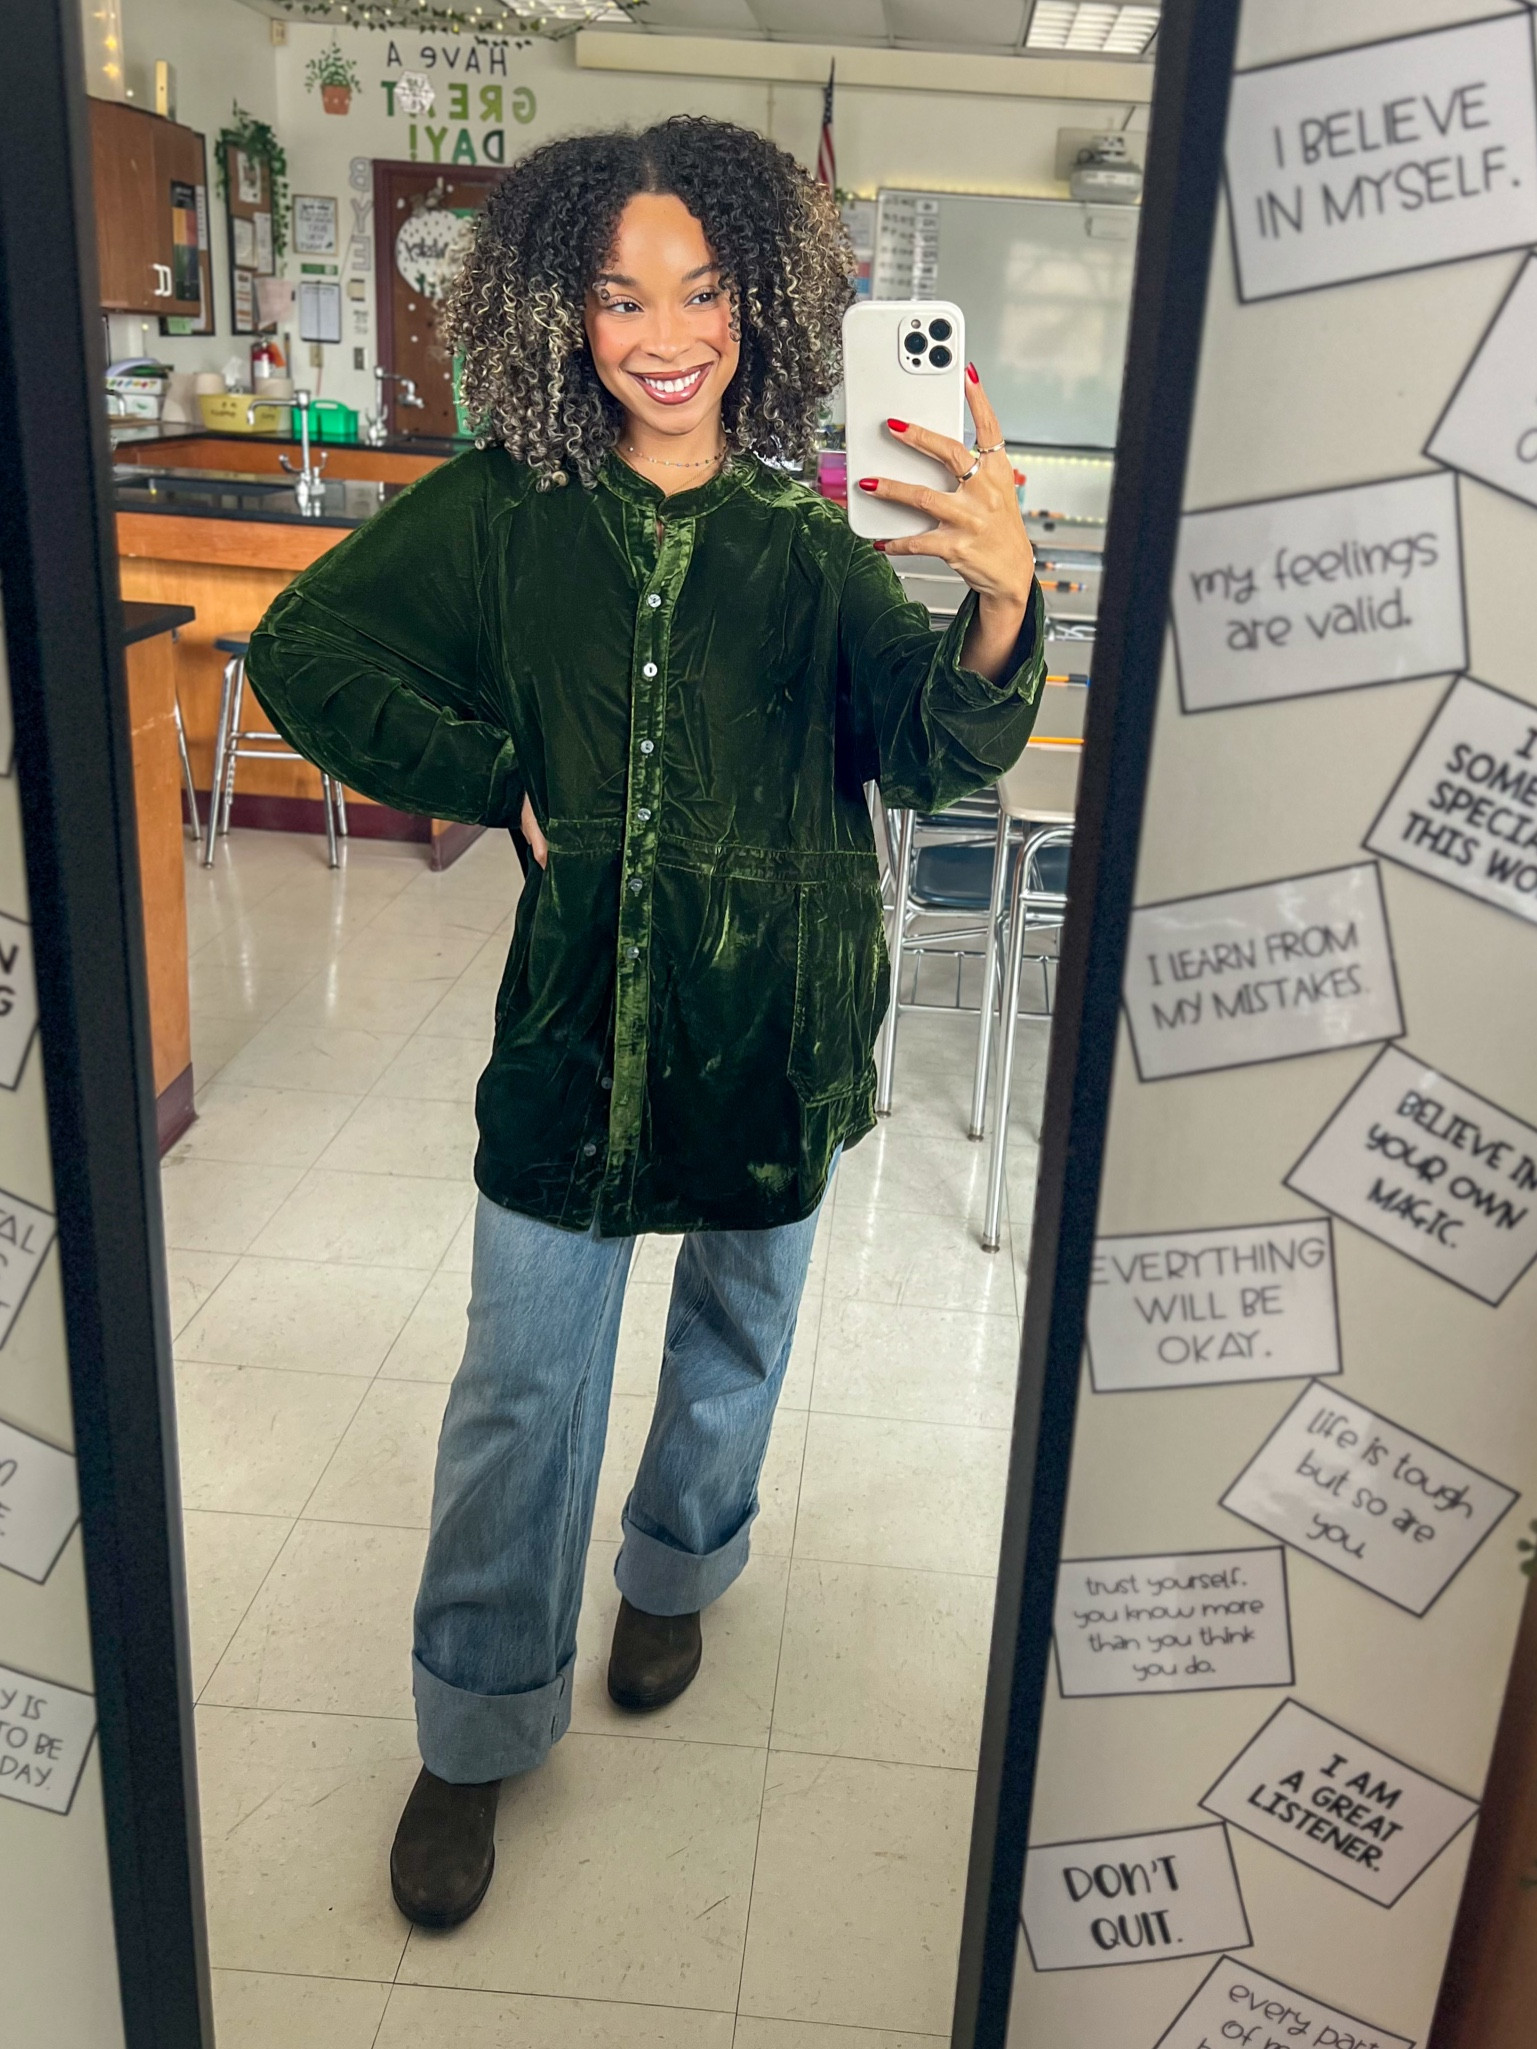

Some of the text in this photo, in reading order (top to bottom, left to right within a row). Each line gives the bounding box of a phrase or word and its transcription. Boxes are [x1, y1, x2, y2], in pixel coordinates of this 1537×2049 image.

[1273, 82, 1490, 170] I BELIEVE
[1256, 145, 1520, 240] IN MYSELF.
[1190, 532, 1438, 605] my feelings
[1225, 587, 1412, 651] are valid.
[1402, 810, 1480, 866] THIS
[1147, 921, 1359, 986] I LEARN FROM
[1151, 964, 1371, 1030] MY MISTAKES.
[1396, 1089, 1537, 1192] BELIEVE IN
[1367, 1176, 1465, 1249] MAGIC.
[1449, 1175, 1529, 1230] OWN
[1091, 1237, 1327, 1286] EVERYTHING
[1133, 1284, 1285, 1325] WILL BE
[1157, 1328, 1273, 1365] OKAY.
[1306, 1407, 1473, 1520] life is tough
[1295, 1448, 1436, 1543] but so are
[1305, 1512, 1366, 1560] you
[1085, 1567, 1248, 1596] trust yourself.
[1074, 1599, 1264, 1629] you know more
[1088, 1625, 1256, 1653] than you think
[1133, 1655, 1216, 1682] you do.
[20, 1694, 48, 1720] IS
[34, 1732, 64, 1761] BE
[1279, 1769, 1404, 1843] A GREAT
[1319, 1753, 1404, 1811] I AM
[1247, 1783, 1384, 1873] LISTENER.
[1090, 1910, 1183, 1951] QUIT.
[1221, 2019, 1263, 2047] of
[1228, 1984, 1313, 2036] every
